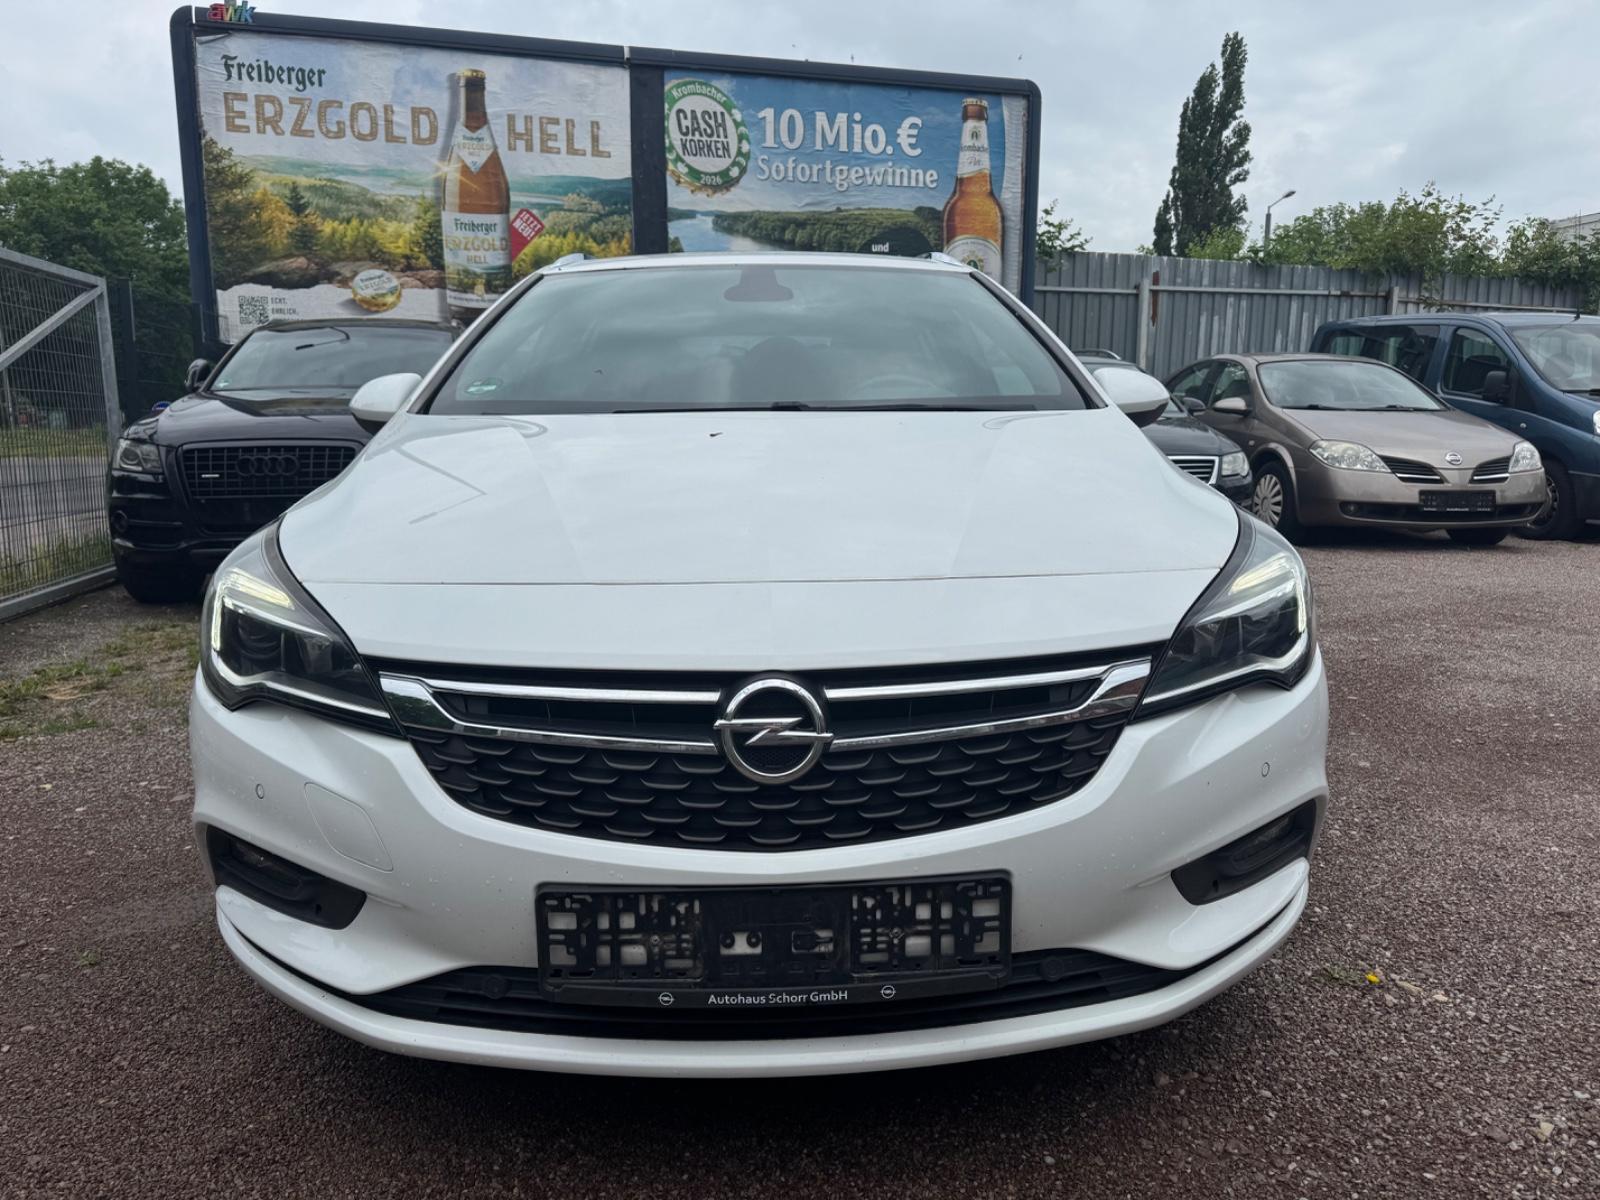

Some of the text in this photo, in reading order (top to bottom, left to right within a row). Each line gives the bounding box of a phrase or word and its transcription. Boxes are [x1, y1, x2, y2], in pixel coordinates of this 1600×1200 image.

[221, 54, 327, 92] Freiberger
[671, 83, 728, 102] Krombacher
[223, 92, 611, 158] ERZGOLD HELL
[675, 108, 729, 140] CASH
[757, 107, 805, 150] 10
[680, 137, 732, 159] KORKEN
[757, 155, 939, 192] Sofortgewinne
[454, 217, 498, 235] Freiberger
[519, 210, 542, 229] JETZT
[872, 242, 889, 252] und
[466, 255, 488, 264] HELL
[708, 990, 848, 1005] Autohaus Schorr GmbH
